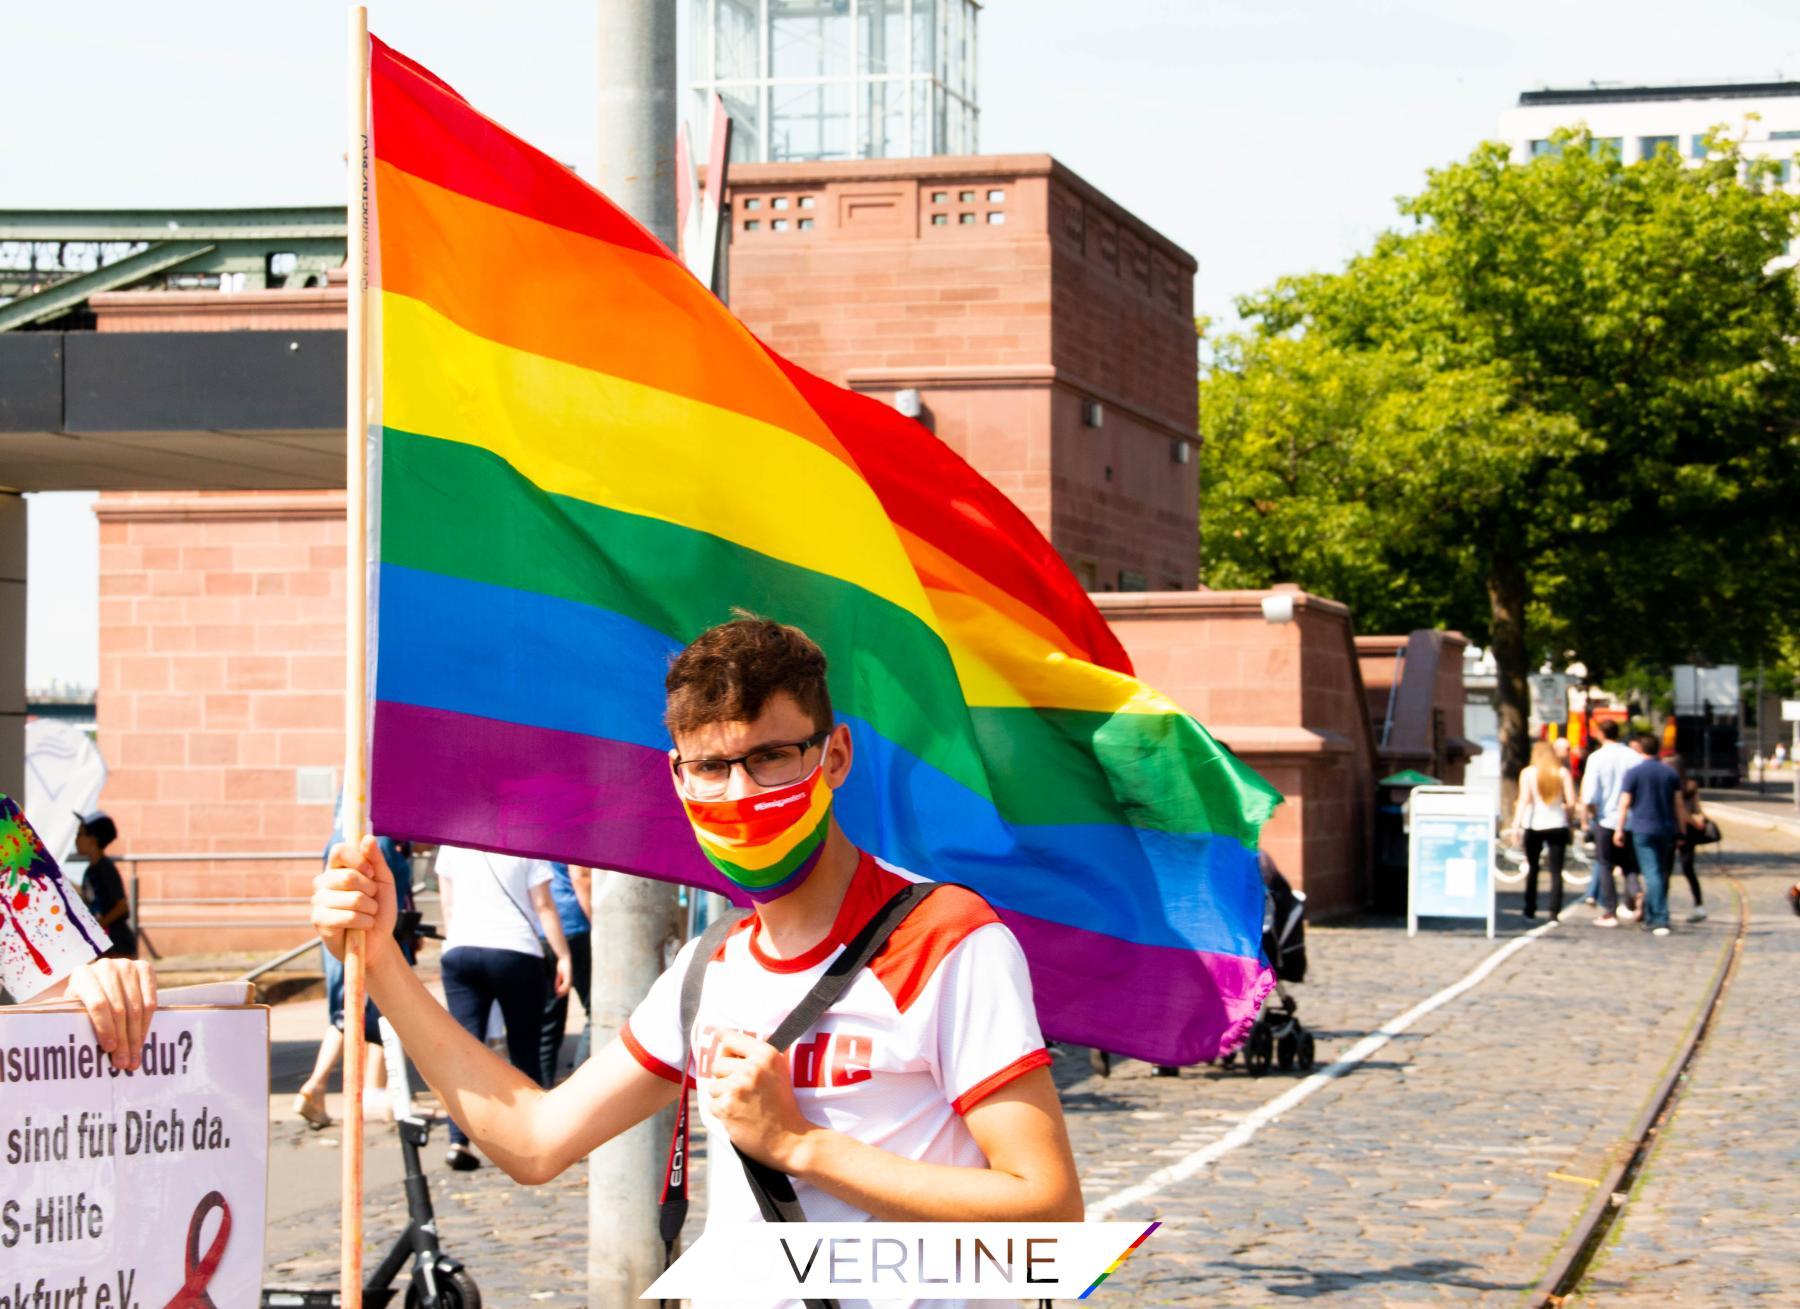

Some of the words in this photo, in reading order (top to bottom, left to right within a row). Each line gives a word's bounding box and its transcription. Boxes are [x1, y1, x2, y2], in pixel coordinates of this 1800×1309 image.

[0, 1034, 134, 1082] sumier
[142, 1031, 193, 1077] du?
[7, 1115, 68, 1165] sind
[78, 1112, 117, 1159] für
[125, 1108, 184, 1155] Dich
[193, 1106, 231, 1150] da.
[1, 1192, 104, 1248] S-Hilfe
